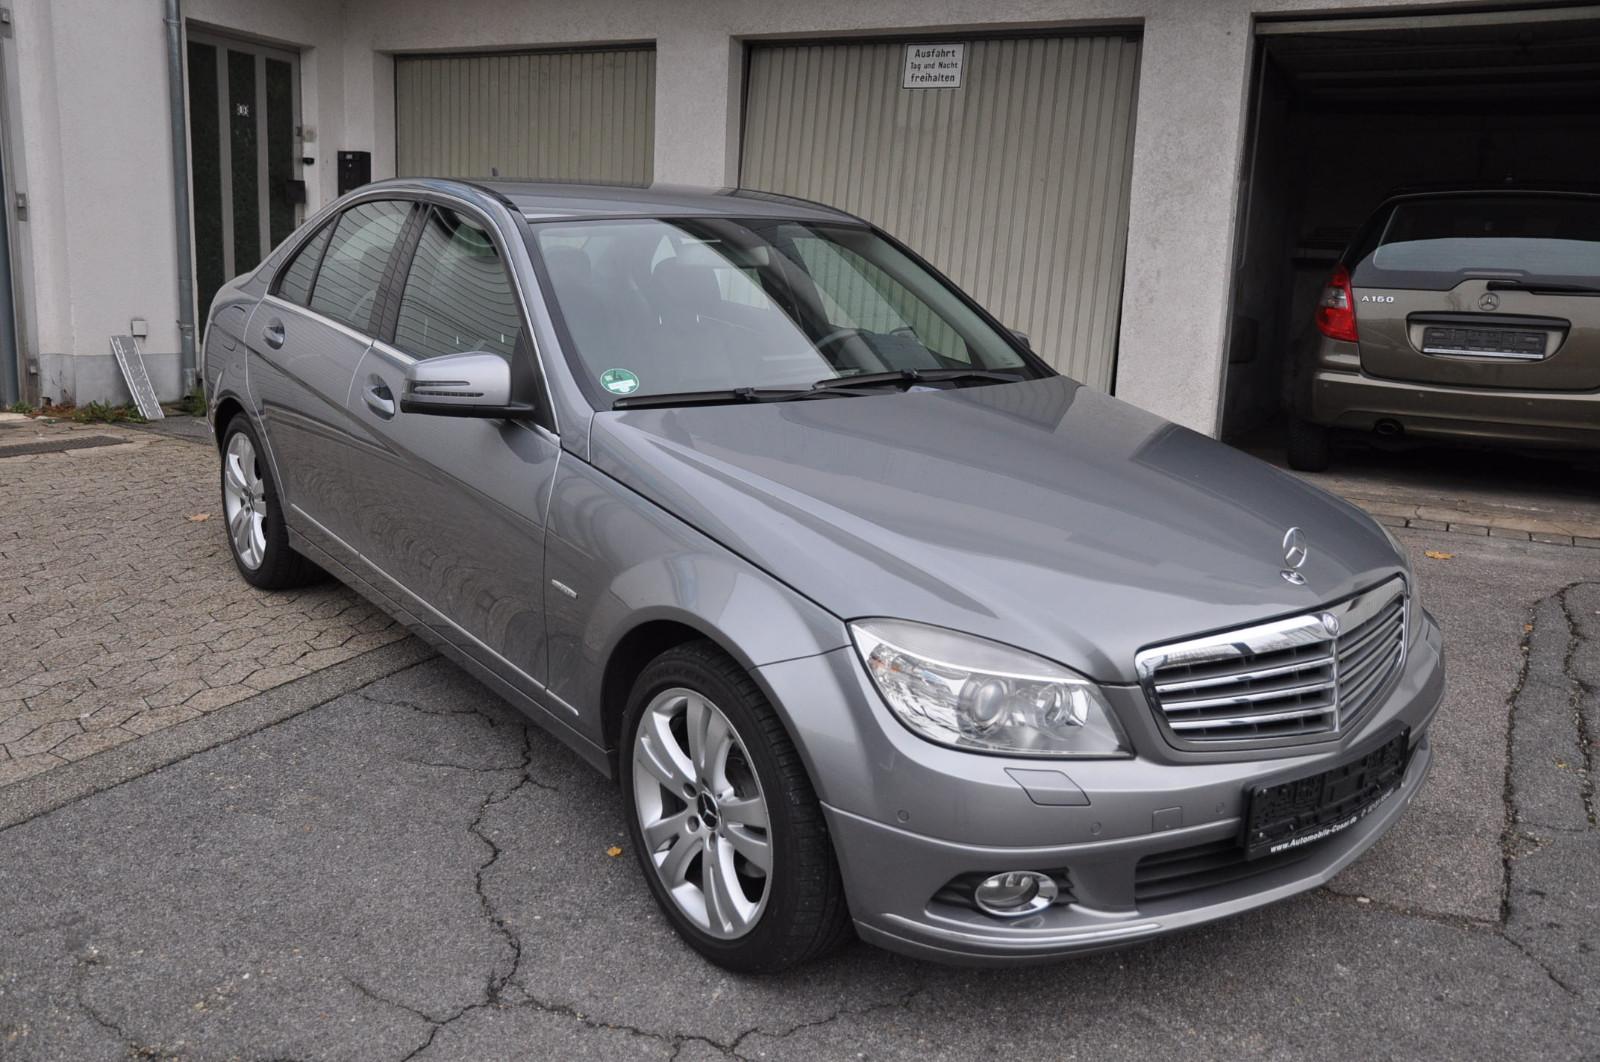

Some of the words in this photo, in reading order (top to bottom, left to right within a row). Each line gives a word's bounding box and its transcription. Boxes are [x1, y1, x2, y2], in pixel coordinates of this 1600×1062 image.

[914, 48, 956, 58] Ausfahrt
[911, 62, 921, 71] Tag
[938, 61, 958, 69] Nacht
[911, 72, 955, 82] freihalten
